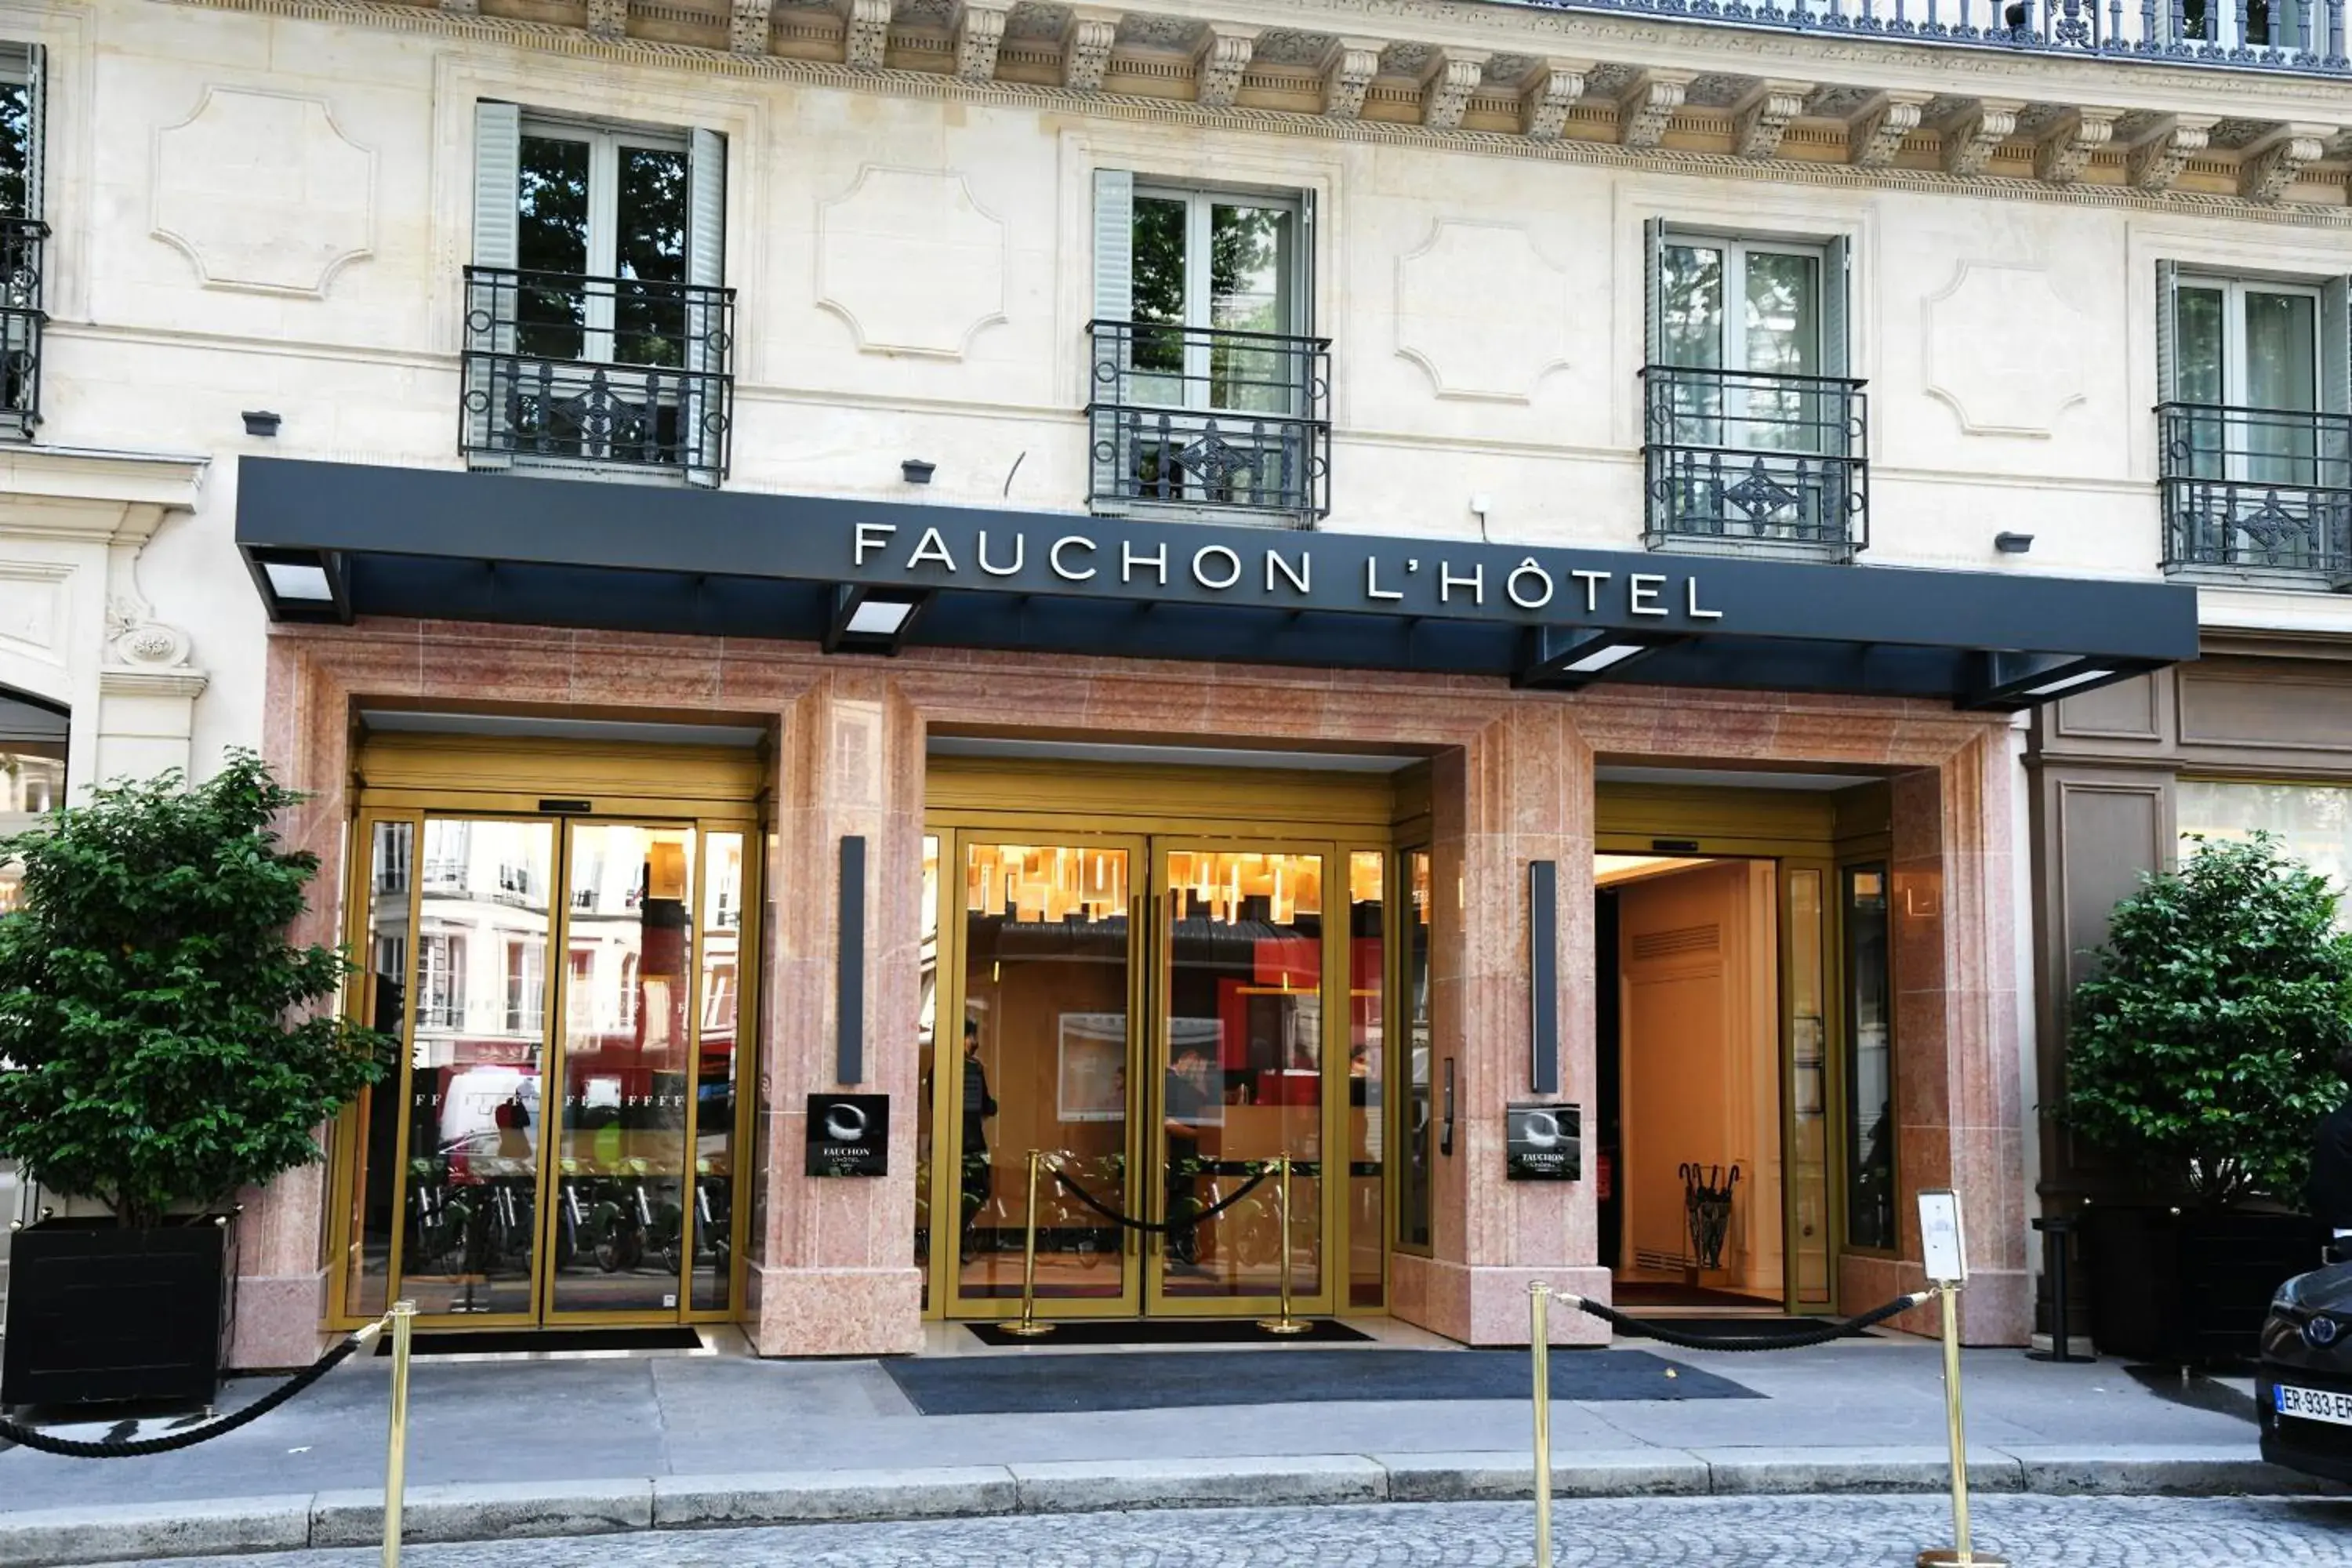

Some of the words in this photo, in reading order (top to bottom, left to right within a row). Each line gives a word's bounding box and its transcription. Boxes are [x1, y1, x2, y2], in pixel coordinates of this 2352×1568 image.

[853, 522, 1310, 593] FAUCHON
[1367, 555, 1724, 618] L'HÔTEL
[823, 1147, 870, 1156] FAUCHON
